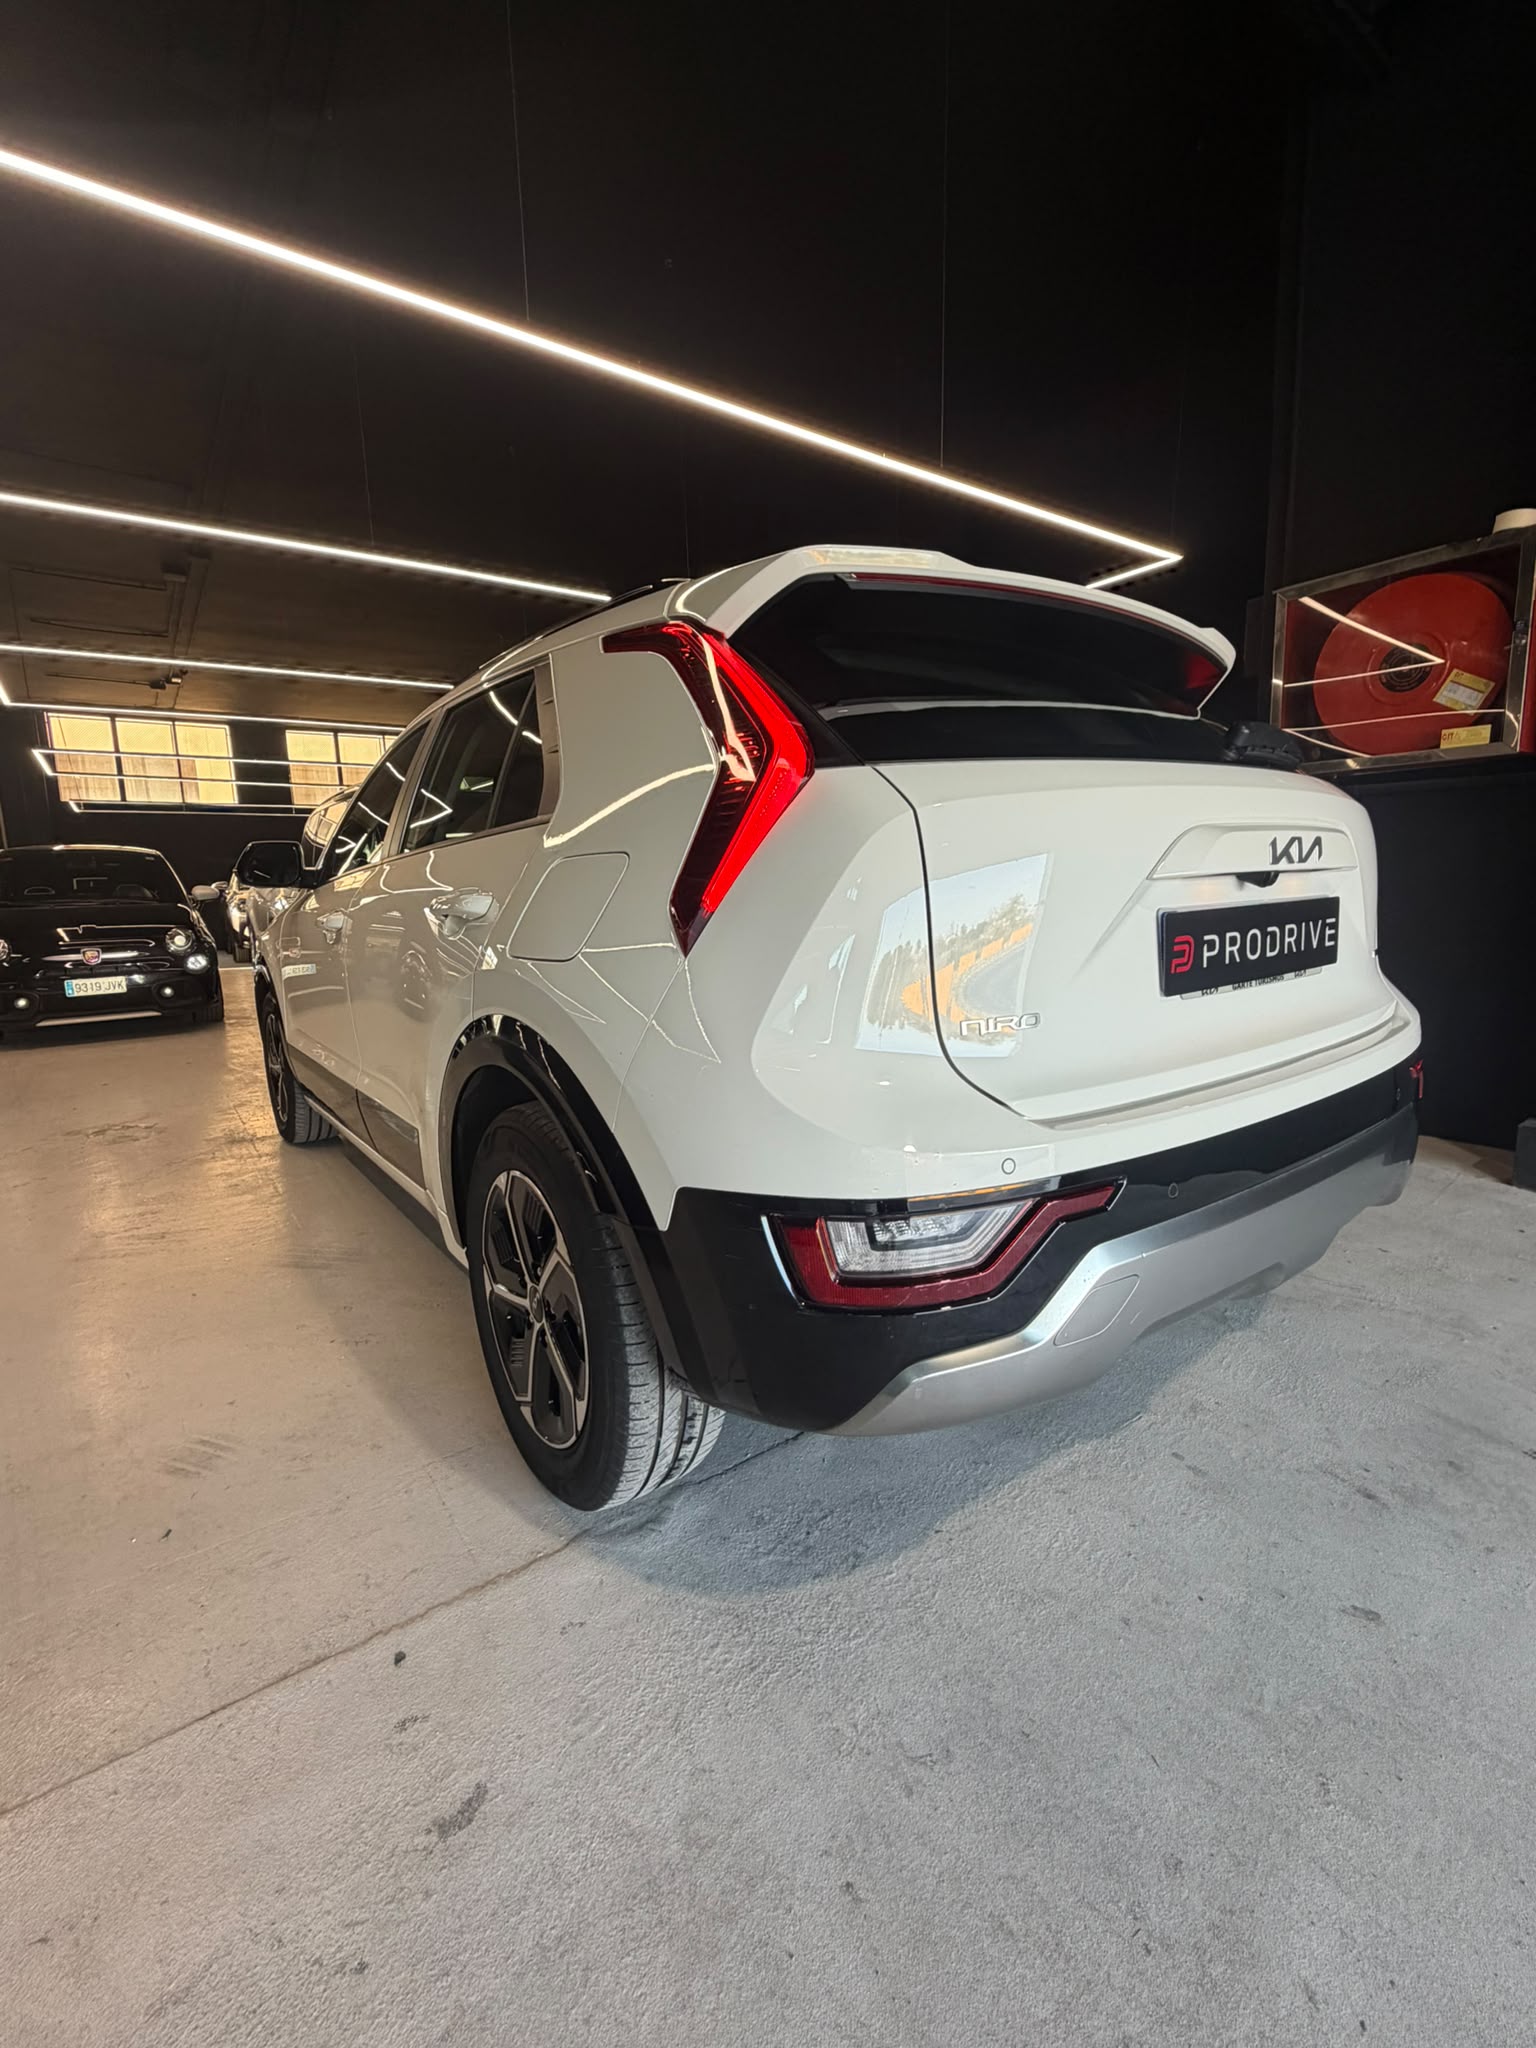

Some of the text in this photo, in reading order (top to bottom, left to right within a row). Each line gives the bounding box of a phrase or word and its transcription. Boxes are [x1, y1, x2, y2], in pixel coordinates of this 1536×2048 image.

[1269, 836, 1322, 865] KIA
[1203, 918, 1336, 968] PRODRIVE
[74, 980, 125, 993] 9319 JVK
[960, 1013, 1040, 1036] NIRO
